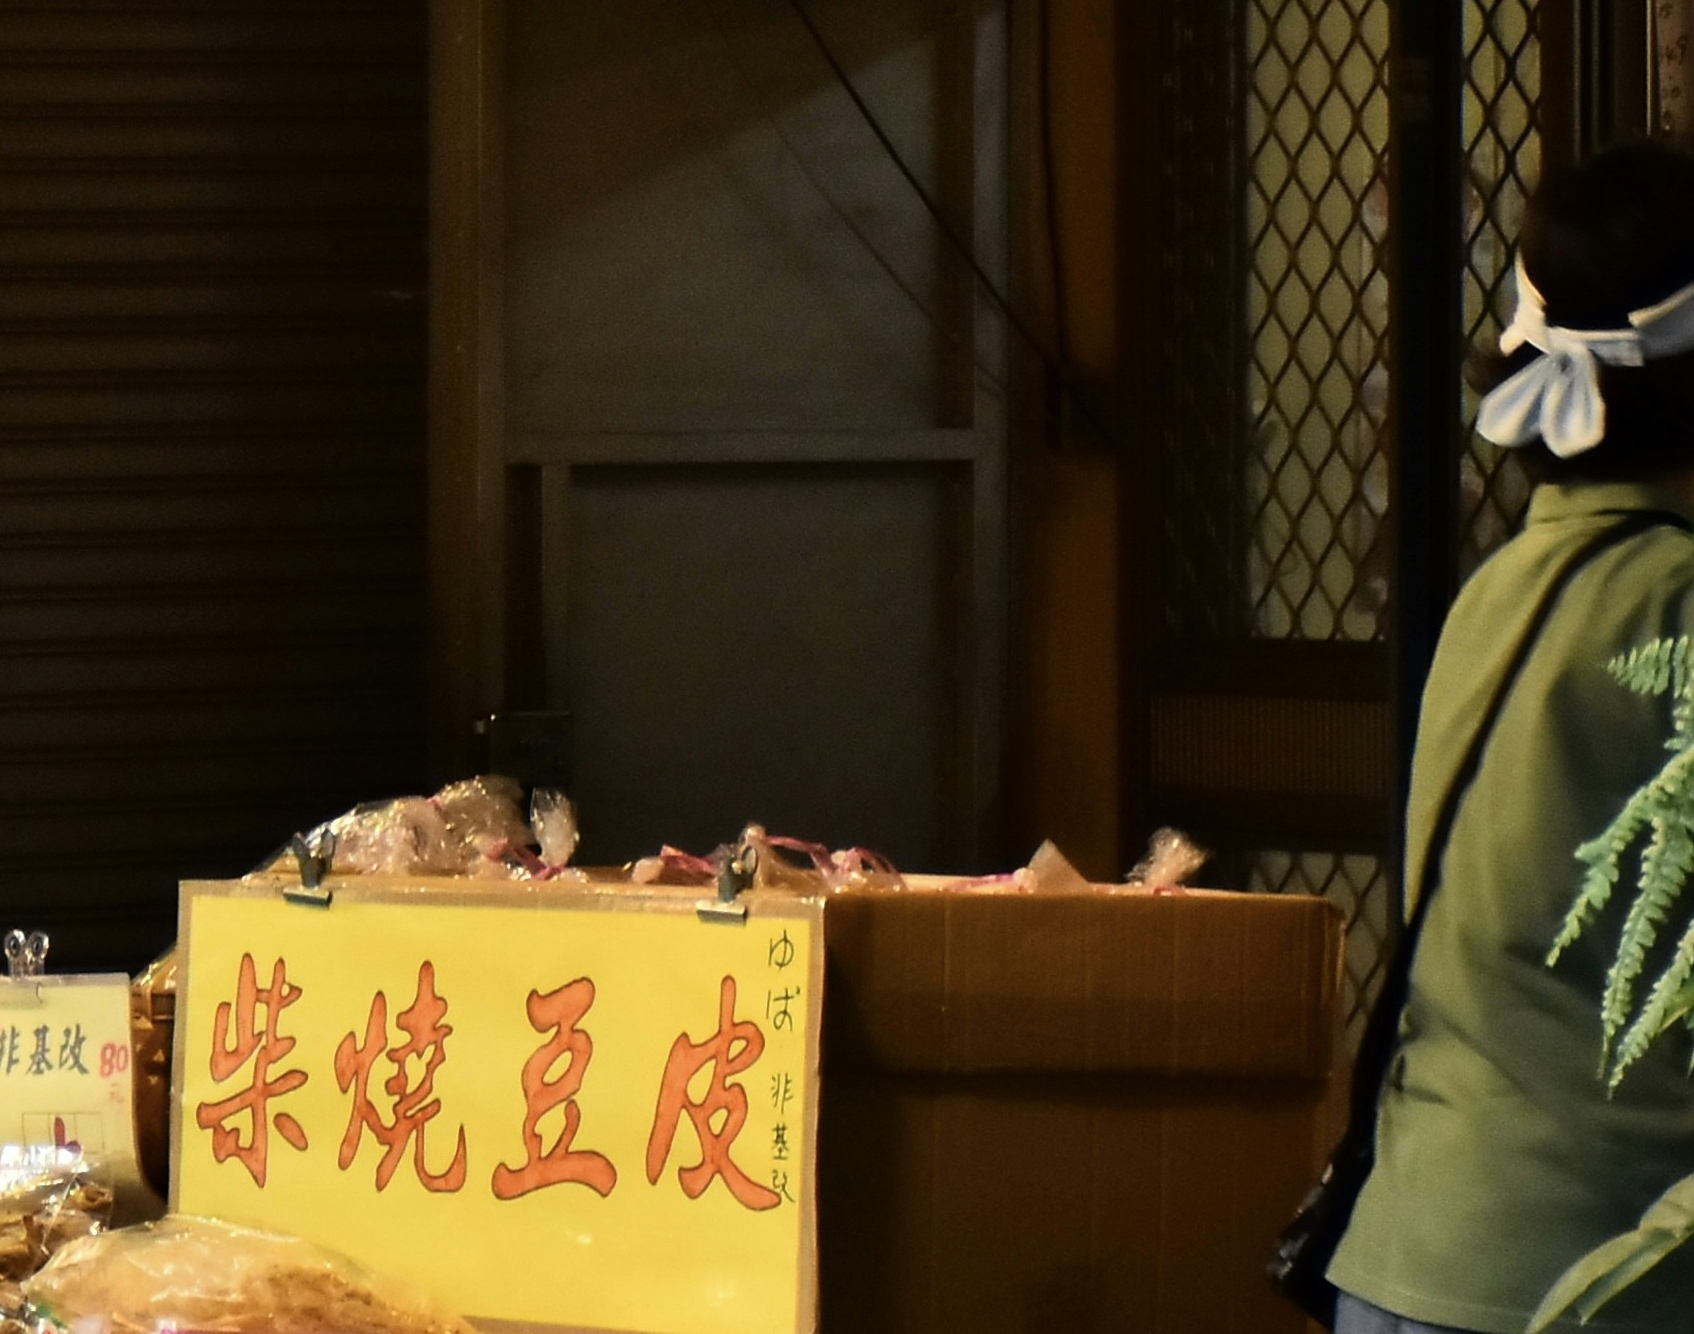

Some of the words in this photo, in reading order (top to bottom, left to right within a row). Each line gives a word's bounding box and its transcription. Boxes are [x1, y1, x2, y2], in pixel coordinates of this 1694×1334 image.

[765, 929, 801, 1033] ゆば
[99, 1042, 130, 1078] 80
[196, 951, 783, 1212] 柴燒豆皮
[770, 1071, 796, 1203] 非基改
